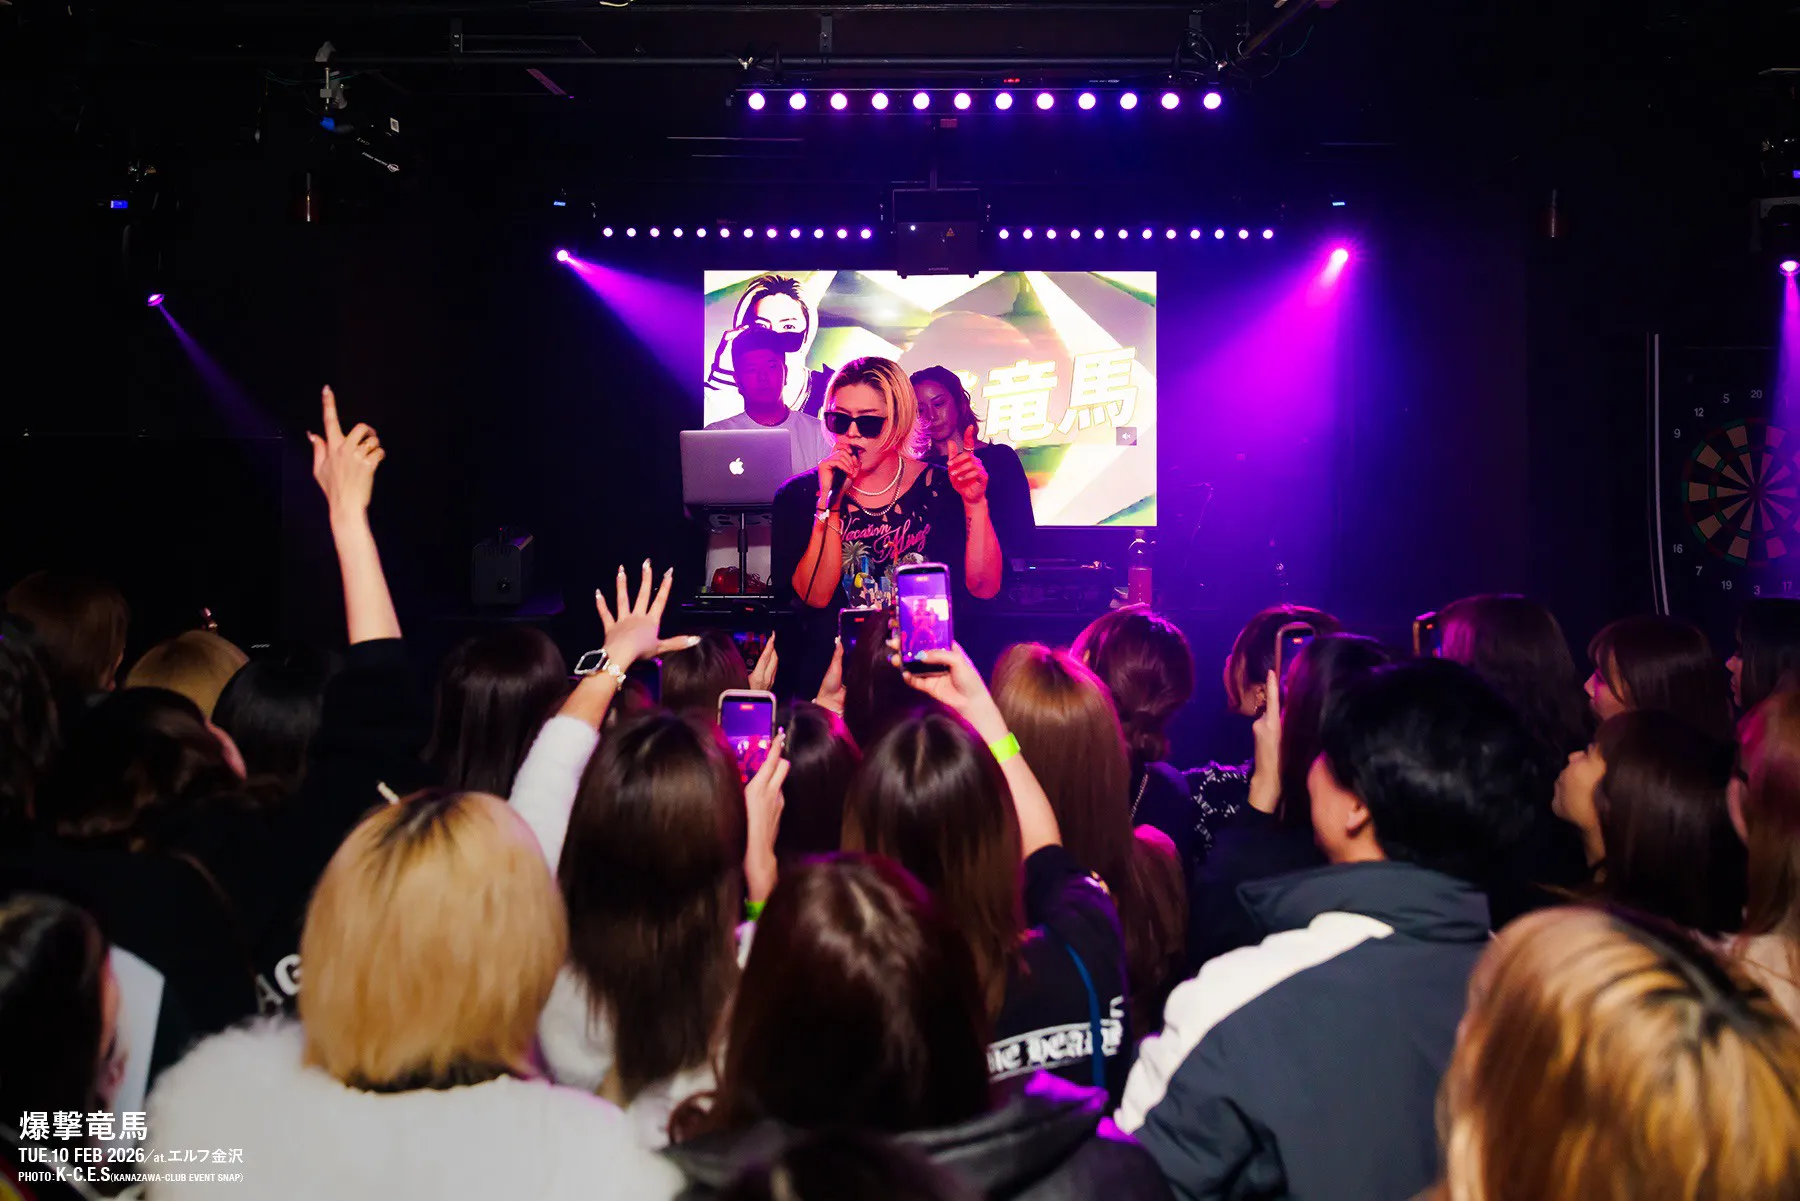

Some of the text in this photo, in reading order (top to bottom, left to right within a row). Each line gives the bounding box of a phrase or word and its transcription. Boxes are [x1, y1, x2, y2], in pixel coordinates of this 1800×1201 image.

[954, 346, 1138, 442] 竜馬
[1722, 393, 1731, 404] 5
[1750, 389, 1763, 399] 20
[1693, 407, 1705, 417] 12
[1673, 428, 1681, 439] 9
[1672, 544, 1684, 554] 16
[1695, 566, 1703, 576] 7
[1721, 580, 1733, 591] 19
[1753, 585, 1761, 596] 3
